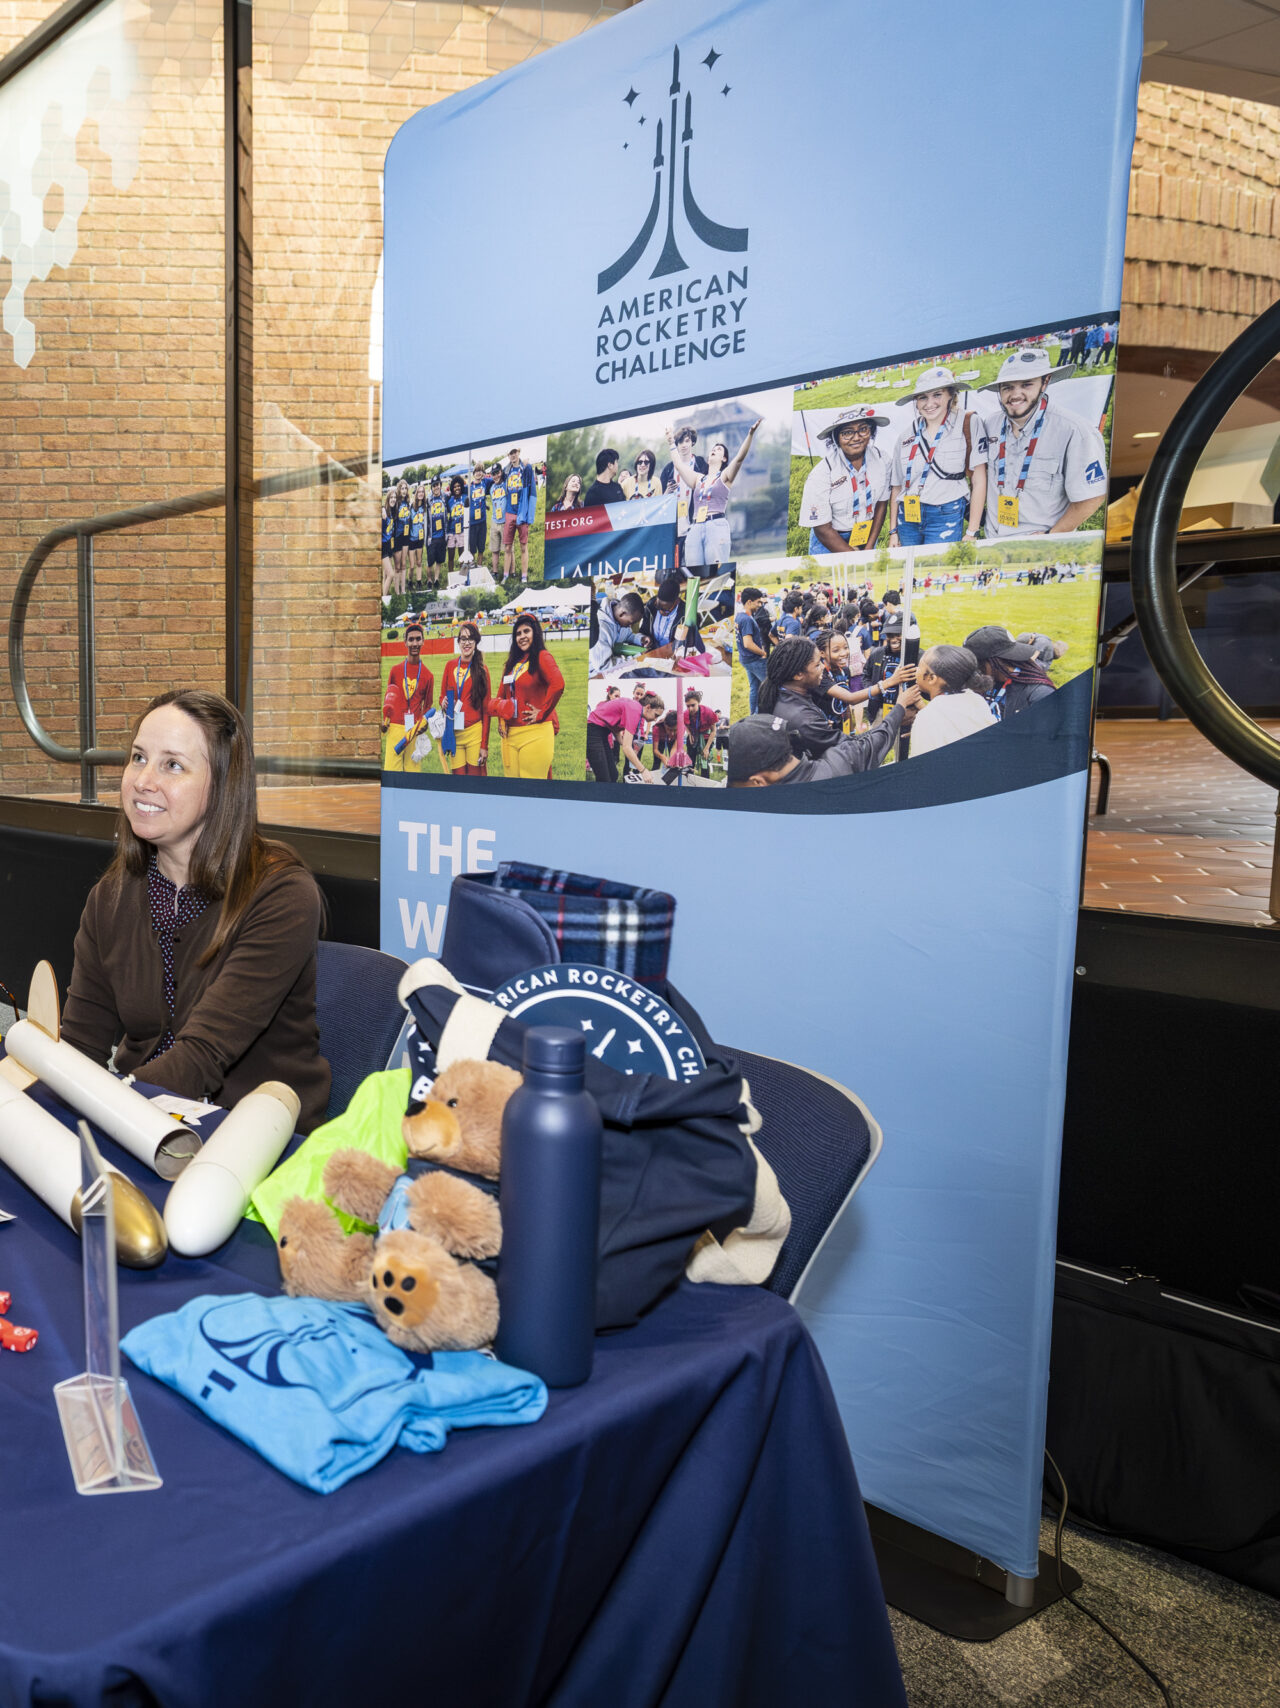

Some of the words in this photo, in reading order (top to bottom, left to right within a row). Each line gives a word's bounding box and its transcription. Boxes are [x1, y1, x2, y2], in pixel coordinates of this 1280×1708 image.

[597, 265, 749, 329] AMERICAN
[596, 297, 748, 357] ROCKETRY
[595, 329, 746, 385] CHALLENGE
[545, 515, 595, 531] TEST.ORG
[398, 820, 497, 878] THE
[567, 967, 685, 1036] ROCKETRY
